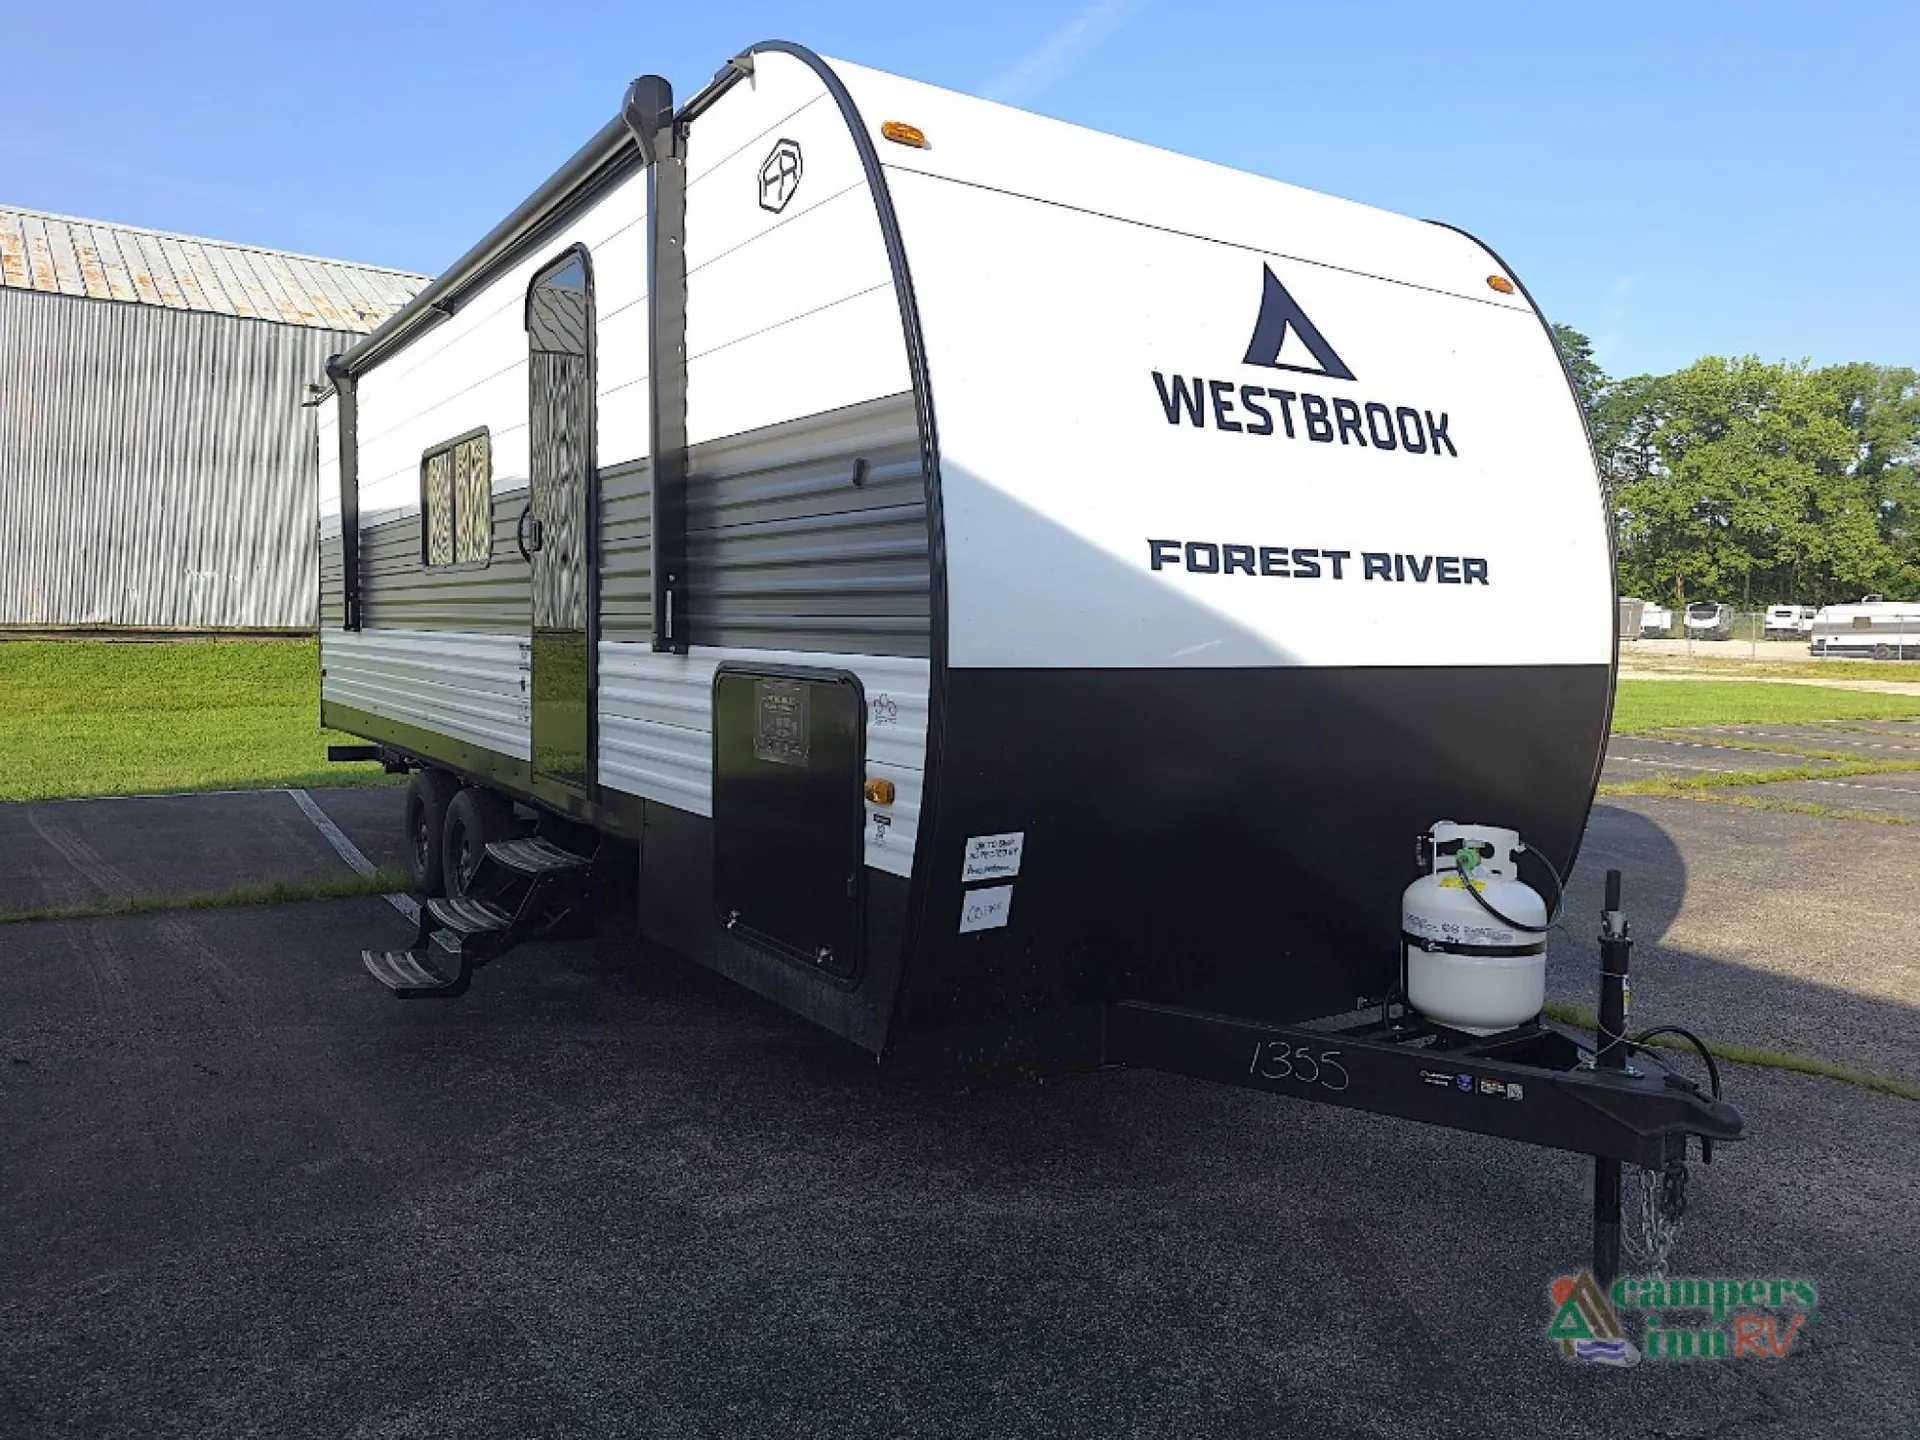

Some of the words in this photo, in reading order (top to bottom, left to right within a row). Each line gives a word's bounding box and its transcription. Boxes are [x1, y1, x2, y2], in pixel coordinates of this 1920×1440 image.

[1152, 371, 1458, 458] WESTBROOK
[1147, 538, 1351, 580] FOREST
[1361, 551, 1489, 586] RIVER
[1249, 1041, 1350, 1091] 1355
